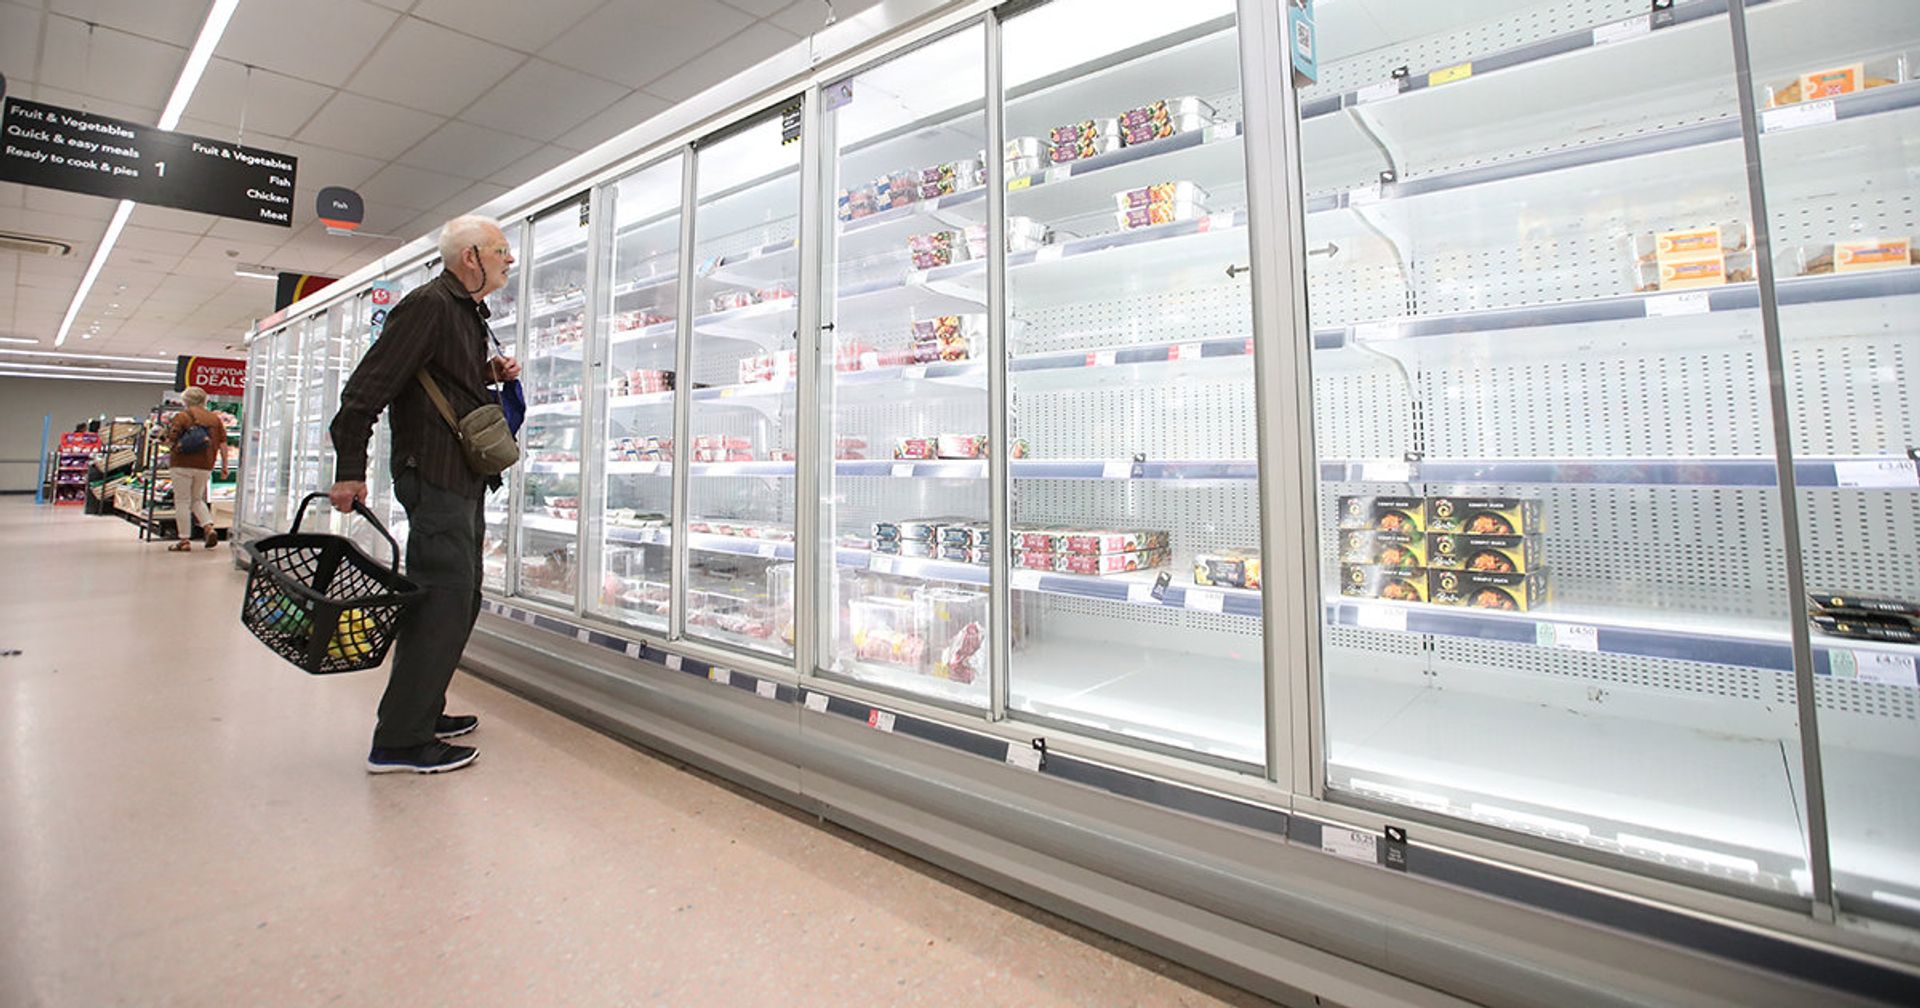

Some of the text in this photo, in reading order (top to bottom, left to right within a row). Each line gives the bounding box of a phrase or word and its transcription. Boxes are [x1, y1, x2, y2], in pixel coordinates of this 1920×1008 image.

[10, 105, 135, 139] Fruit & Vegetables
[7, 124, 140, 159] Quick & easy meals
[6, 145, 139, 178] Ready to cook & pies
[192, 142, 293, 172] Fruit & Vegetables
[154, 161, 166, 177] 1
[269, 175, 291, 188] Fish
[246, 188, 289, 205] Chicken
[333, 200, 349, 209] Fish
[260, 208, 288, 221] Meat
[196, 374, 246, 389] DEALS
